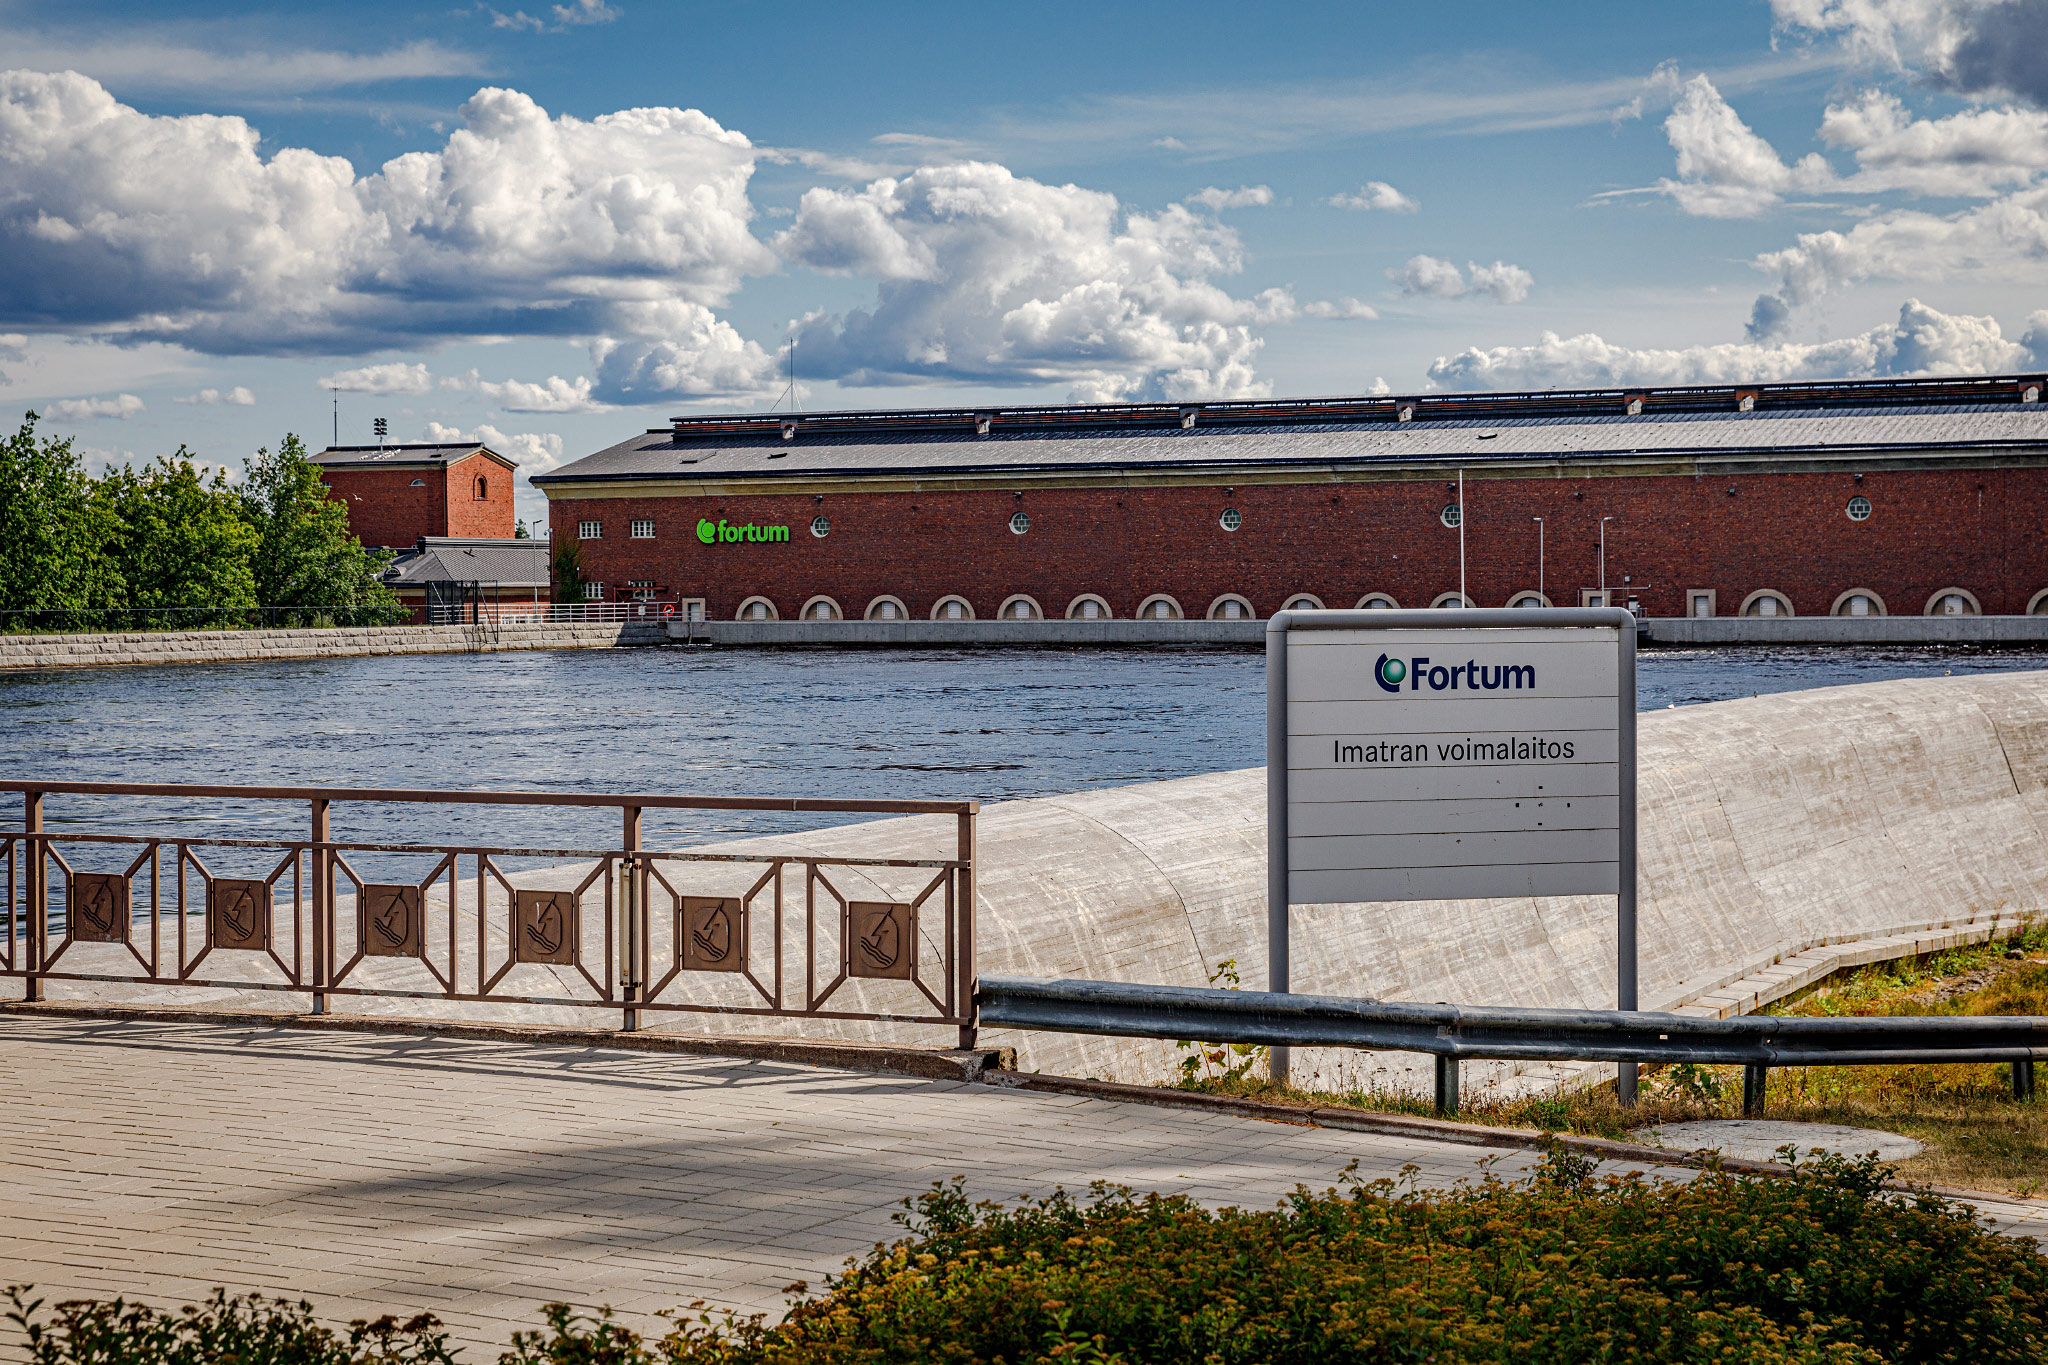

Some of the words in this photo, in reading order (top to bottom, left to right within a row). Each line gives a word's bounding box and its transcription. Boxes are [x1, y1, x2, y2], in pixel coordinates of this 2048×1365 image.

[718, 519, 790, 542] fortum
[1411, 657, 1535, 691] Fortum
[1334, 740, 1428, 763] Imatran
[1437, 736, 1575, 761] voimalaitos
